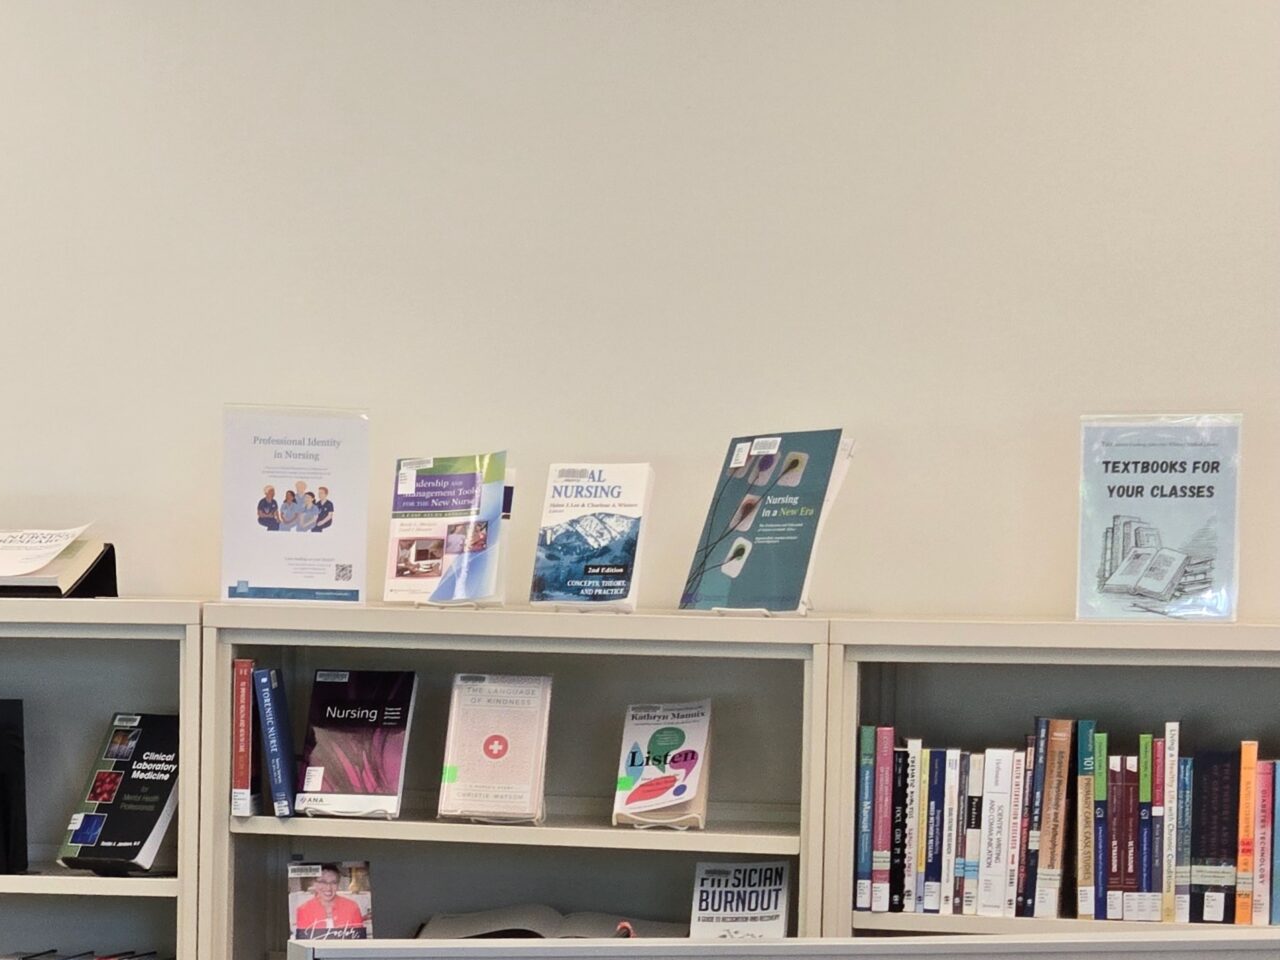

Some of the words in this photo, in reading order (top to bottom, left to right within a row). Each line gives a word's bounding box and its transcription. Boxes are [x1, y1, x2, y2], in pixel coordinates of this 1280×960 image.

[253, 436, 305, 446] Professional
[308, 437, 341, 448] Identity
[274, 451, 282, 459] in
[285, 451, 320, 461] Nursing
[1102, 461, 1187, 474] TEXTBOOKS
[1192, 461, 1220, 473] FOR
[552, 485, 622, 498] NURSING
[1107, 485, 1144, 498] YOUR
[1150, 485, 1215, 498] CLASSES
[432, 498, 448, 506] New
[765, 495, 799, 505] Nursing
[762, 508, 770, 517] in
[779, 507, 797, 516] New
[800, 506, 814, 516] Era
[488, 688, 537, 696] LANGUAGE
[262, 688, 273, 725] FORENSIC
[486, 698, 532, 706] KINDNESS
[325, 706, 378, 722] Nursing
[630, 712, 669, 721] Kathryn
[671, 710, 706, 720] Mannix
[267, 727, 278, 752] NURSE
[143, 752, 175, 761] Clinical
[628, 750, 696, 768] Listen
[1084, 756, 1093, 770] 101
[132, 761, 177, 772] Laboratory
[1166, 759, 1175, 788] Healthy
[131, 772, 170, 781] Medicine
[1083, 777, 1091, 809] PRIMARY
[1083, 810, 1091, 829] CARE
[986, 814, 994, 868] COMMUNICATION
[1083, 831, 1091, 849] CASE
[1166, 823, 1174, 851] Chronic
[994, 837, 1002, 863] WRITING
[1083, 850, 1091, 880] STUDIES
[1258, 831, 1266, 885] TECHNOLOGY
[1165, 853, 1173, 893] Conditions
[698, 889, 782, 912] BURNOUT
